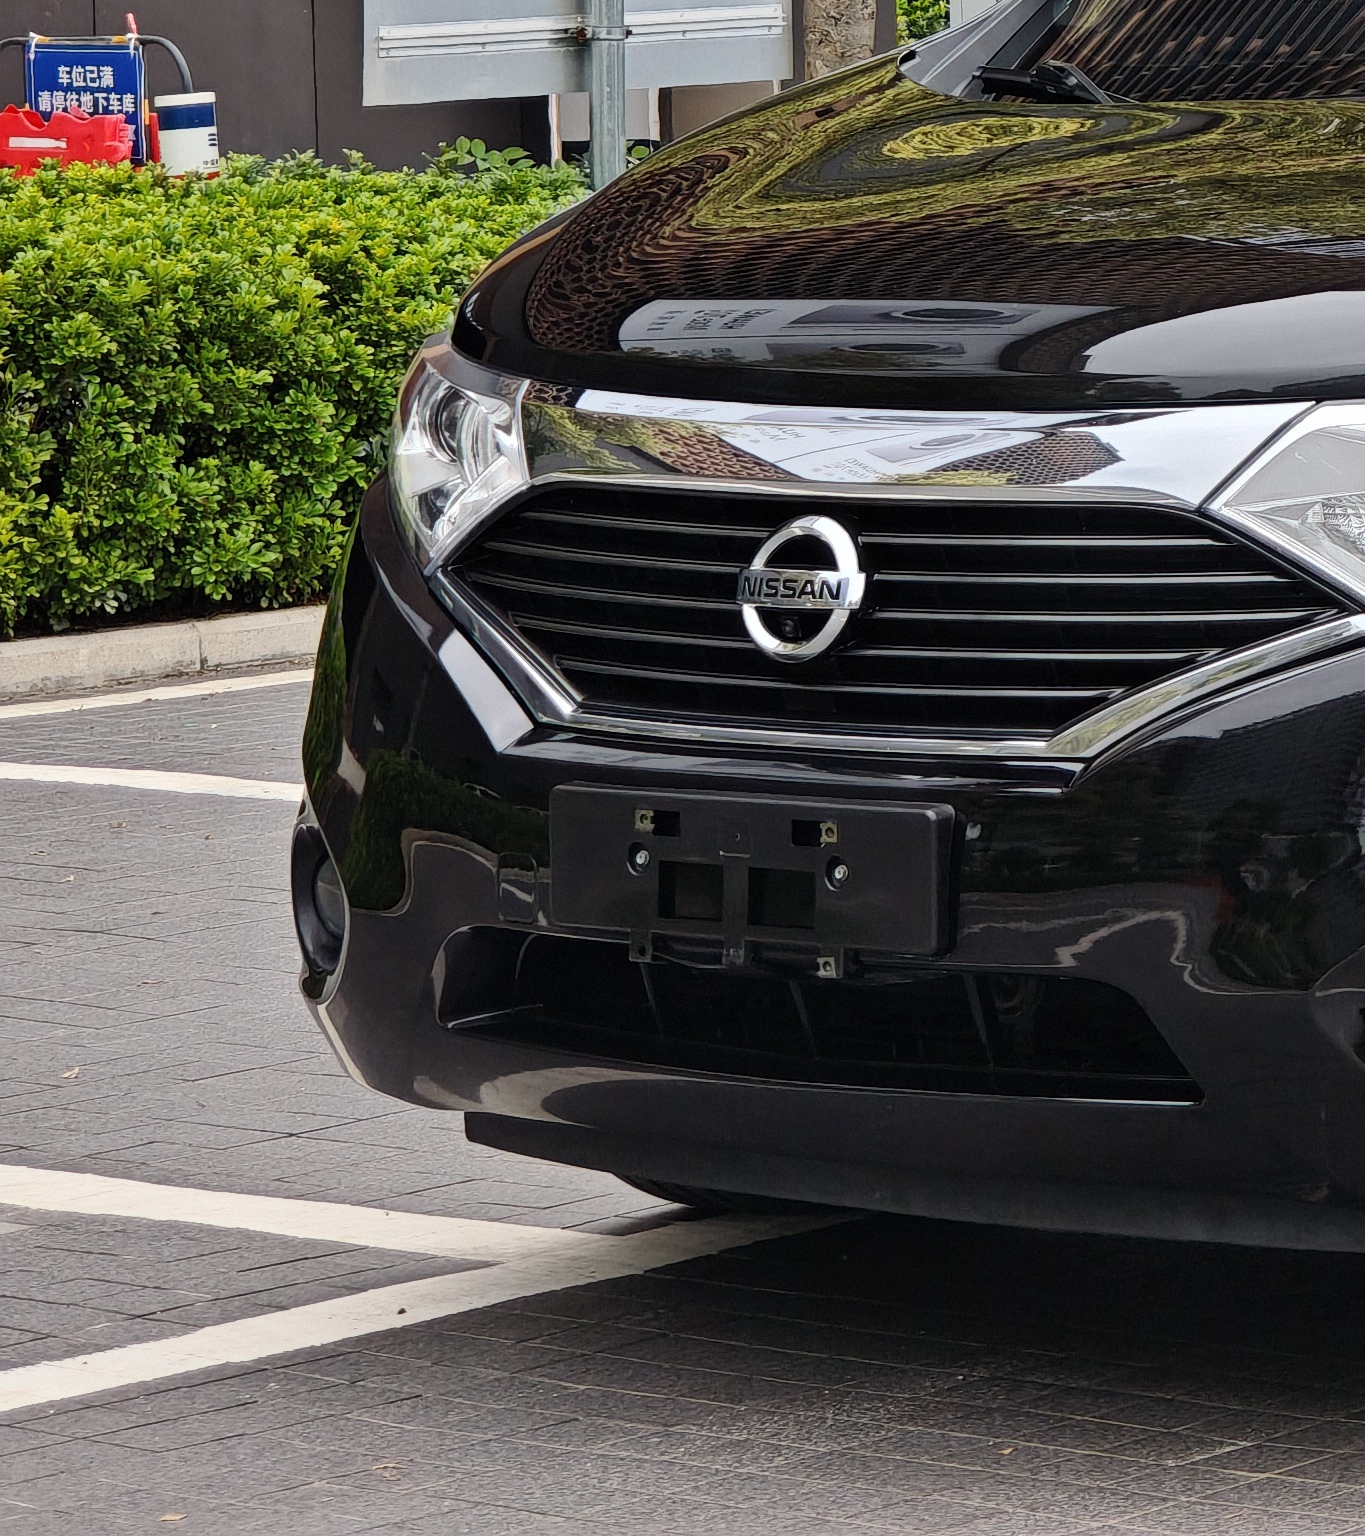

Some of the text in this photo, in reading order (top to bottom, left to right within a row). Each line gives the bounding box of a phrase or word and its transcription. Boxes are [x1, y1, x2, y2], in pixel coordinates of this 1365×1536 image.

[57, 65, 114, 88] 车位已满
[741, 576, 842, 601] NISSAN
